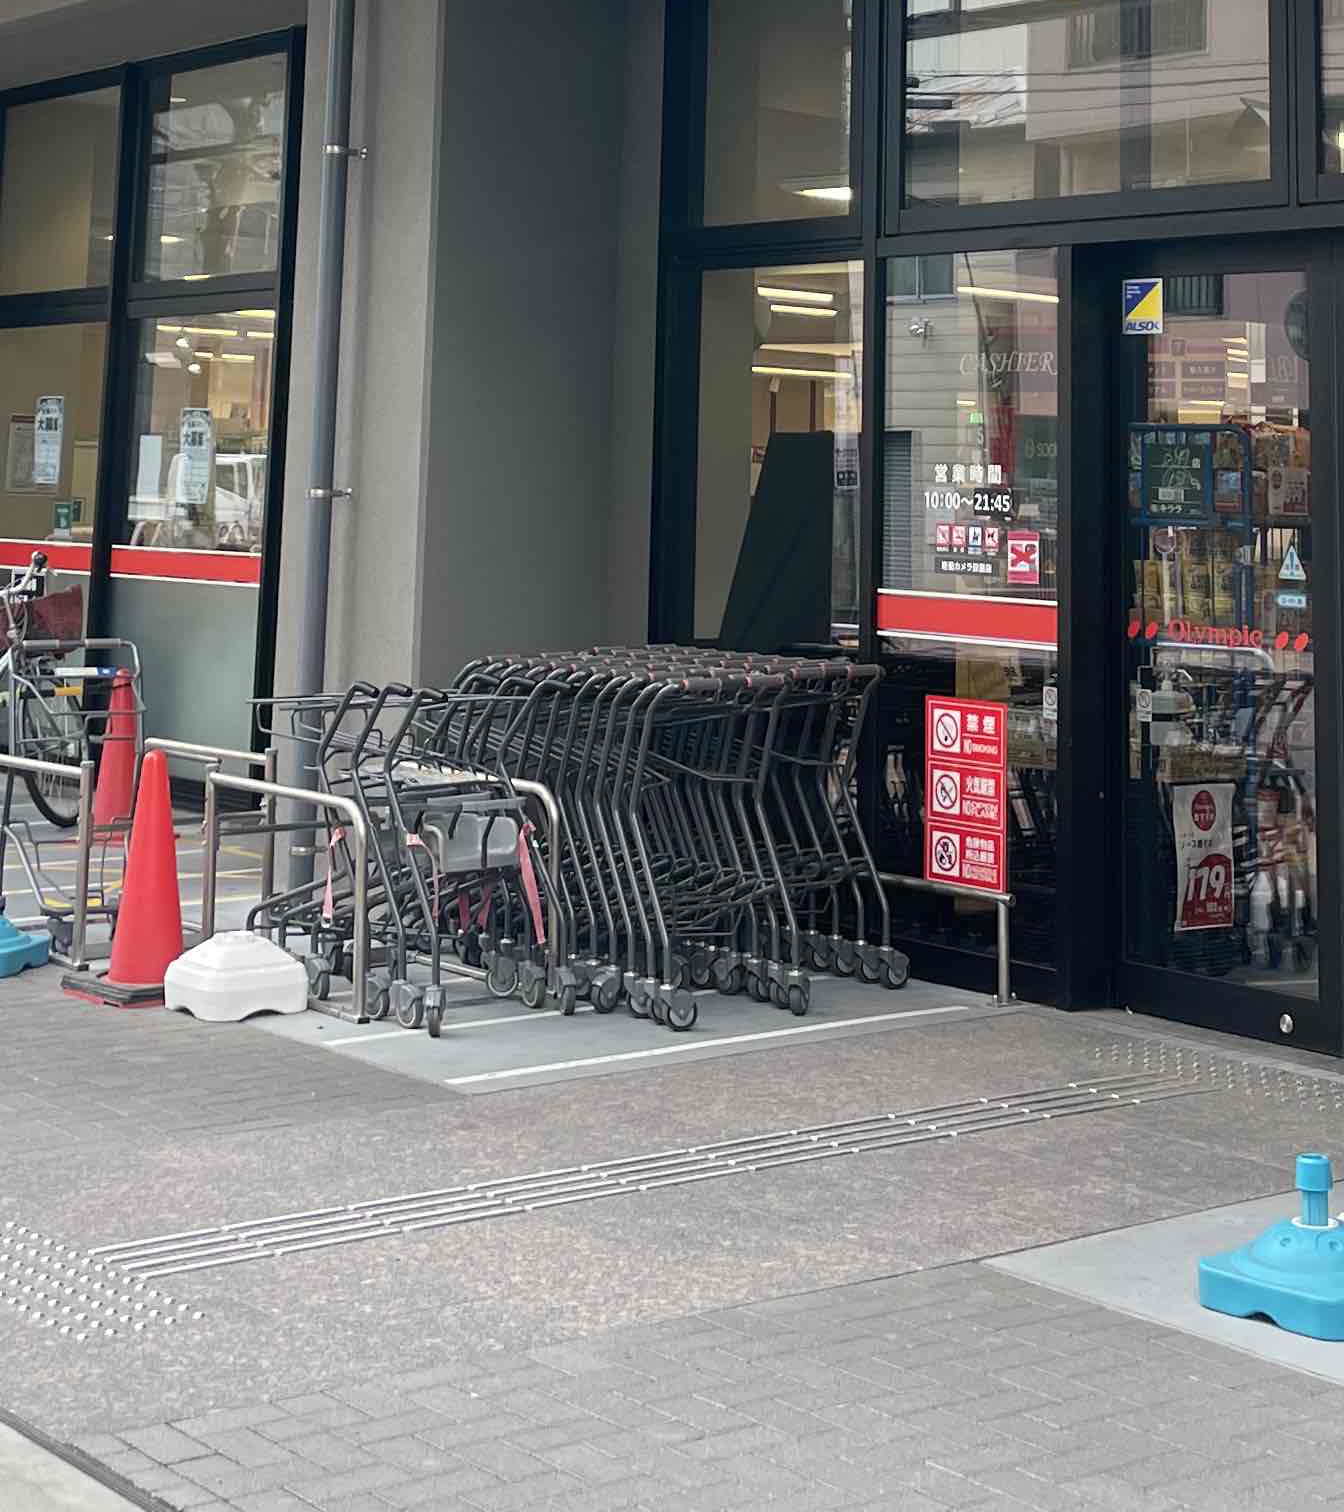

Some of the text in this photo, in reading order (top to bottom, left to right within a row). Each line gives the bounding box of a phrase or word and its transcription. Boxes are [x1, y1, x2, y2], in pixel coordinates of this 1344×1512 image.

[1125, 321, 1161, 331] ALSOK
[959, 351, 1058, 376] CASHIER
[934, 463, 1002, 485] 営業時間
[1167, 617, 1264, 649] Olympic
